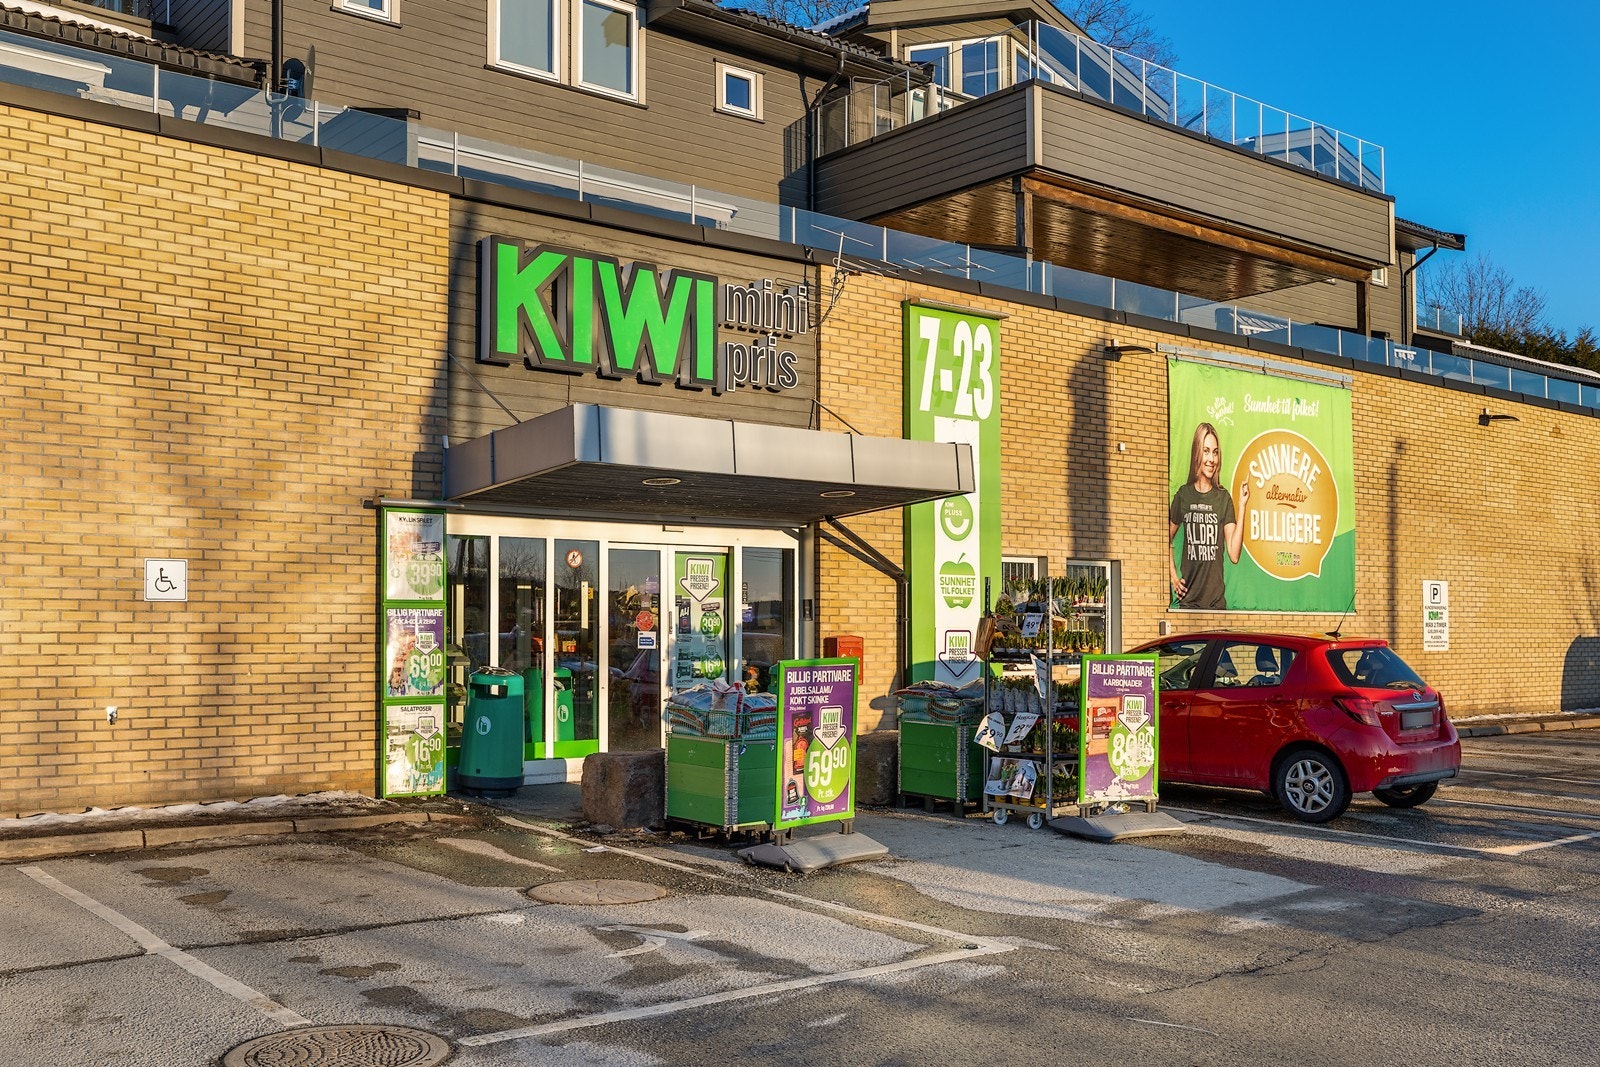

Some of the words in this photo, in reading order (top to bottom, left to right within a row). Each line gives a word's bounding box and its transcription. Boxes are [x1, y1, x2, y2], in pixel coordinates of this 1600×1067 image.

[489, 239, 717, 385] KIWI
[726, 278, 807, 334] mini
[726, 335, 798, 391] pris
[919, 315, 994, 420] 7-23
[1244, 393, 1280, 414] Sunnhet
[1282, 398, 1291, 415] til
[1291, 399, 1319, 422] folket!
[1249, 443, 1321, 493] SUNNERE
[1266, 484, 1307, 503] alternativ
[1204, 513, 1218, 524] OSS
[1250, 509, 1322, 545] BILLIGERE
[1186, 523, 1218, 545] ALDRI
[690, 563, 710, 575] KIWI
[690, 575, 709, 583] PRESSER
[940, 576, 976, 587] SUNNHET
[690, 582, 709, 590] PRISENE!
[941, 587, 951, 595] TIL
[952, 587, 975, 595] FOLKET
[1432, 587, 1439, 600] P
[409, 608, 442, 617] PARTIVARE
[949, 636, 968, 648] KIWI
[949, 648, 967, 656] PRESSER
[1092, 663, 1115, 675] BILLIG
[1116, 665, 1155, 677] PARTIVARE
[787, 671, 811, 683] BILLIG
[812, 670, 852, 682] PARTIVARE
[1103, 679, 1143, 688] KARBONADER
[790, 685, 833, 695] JUBELSALAMI/
[789, 696, 807, 705] KOKT
[807, 695, 829, 704] SKINKE
[1126, 699, 1143, 710] KIWI
[823, 711, 839, 723] KIWI
[822, 722, 838, 731] PRESSER
